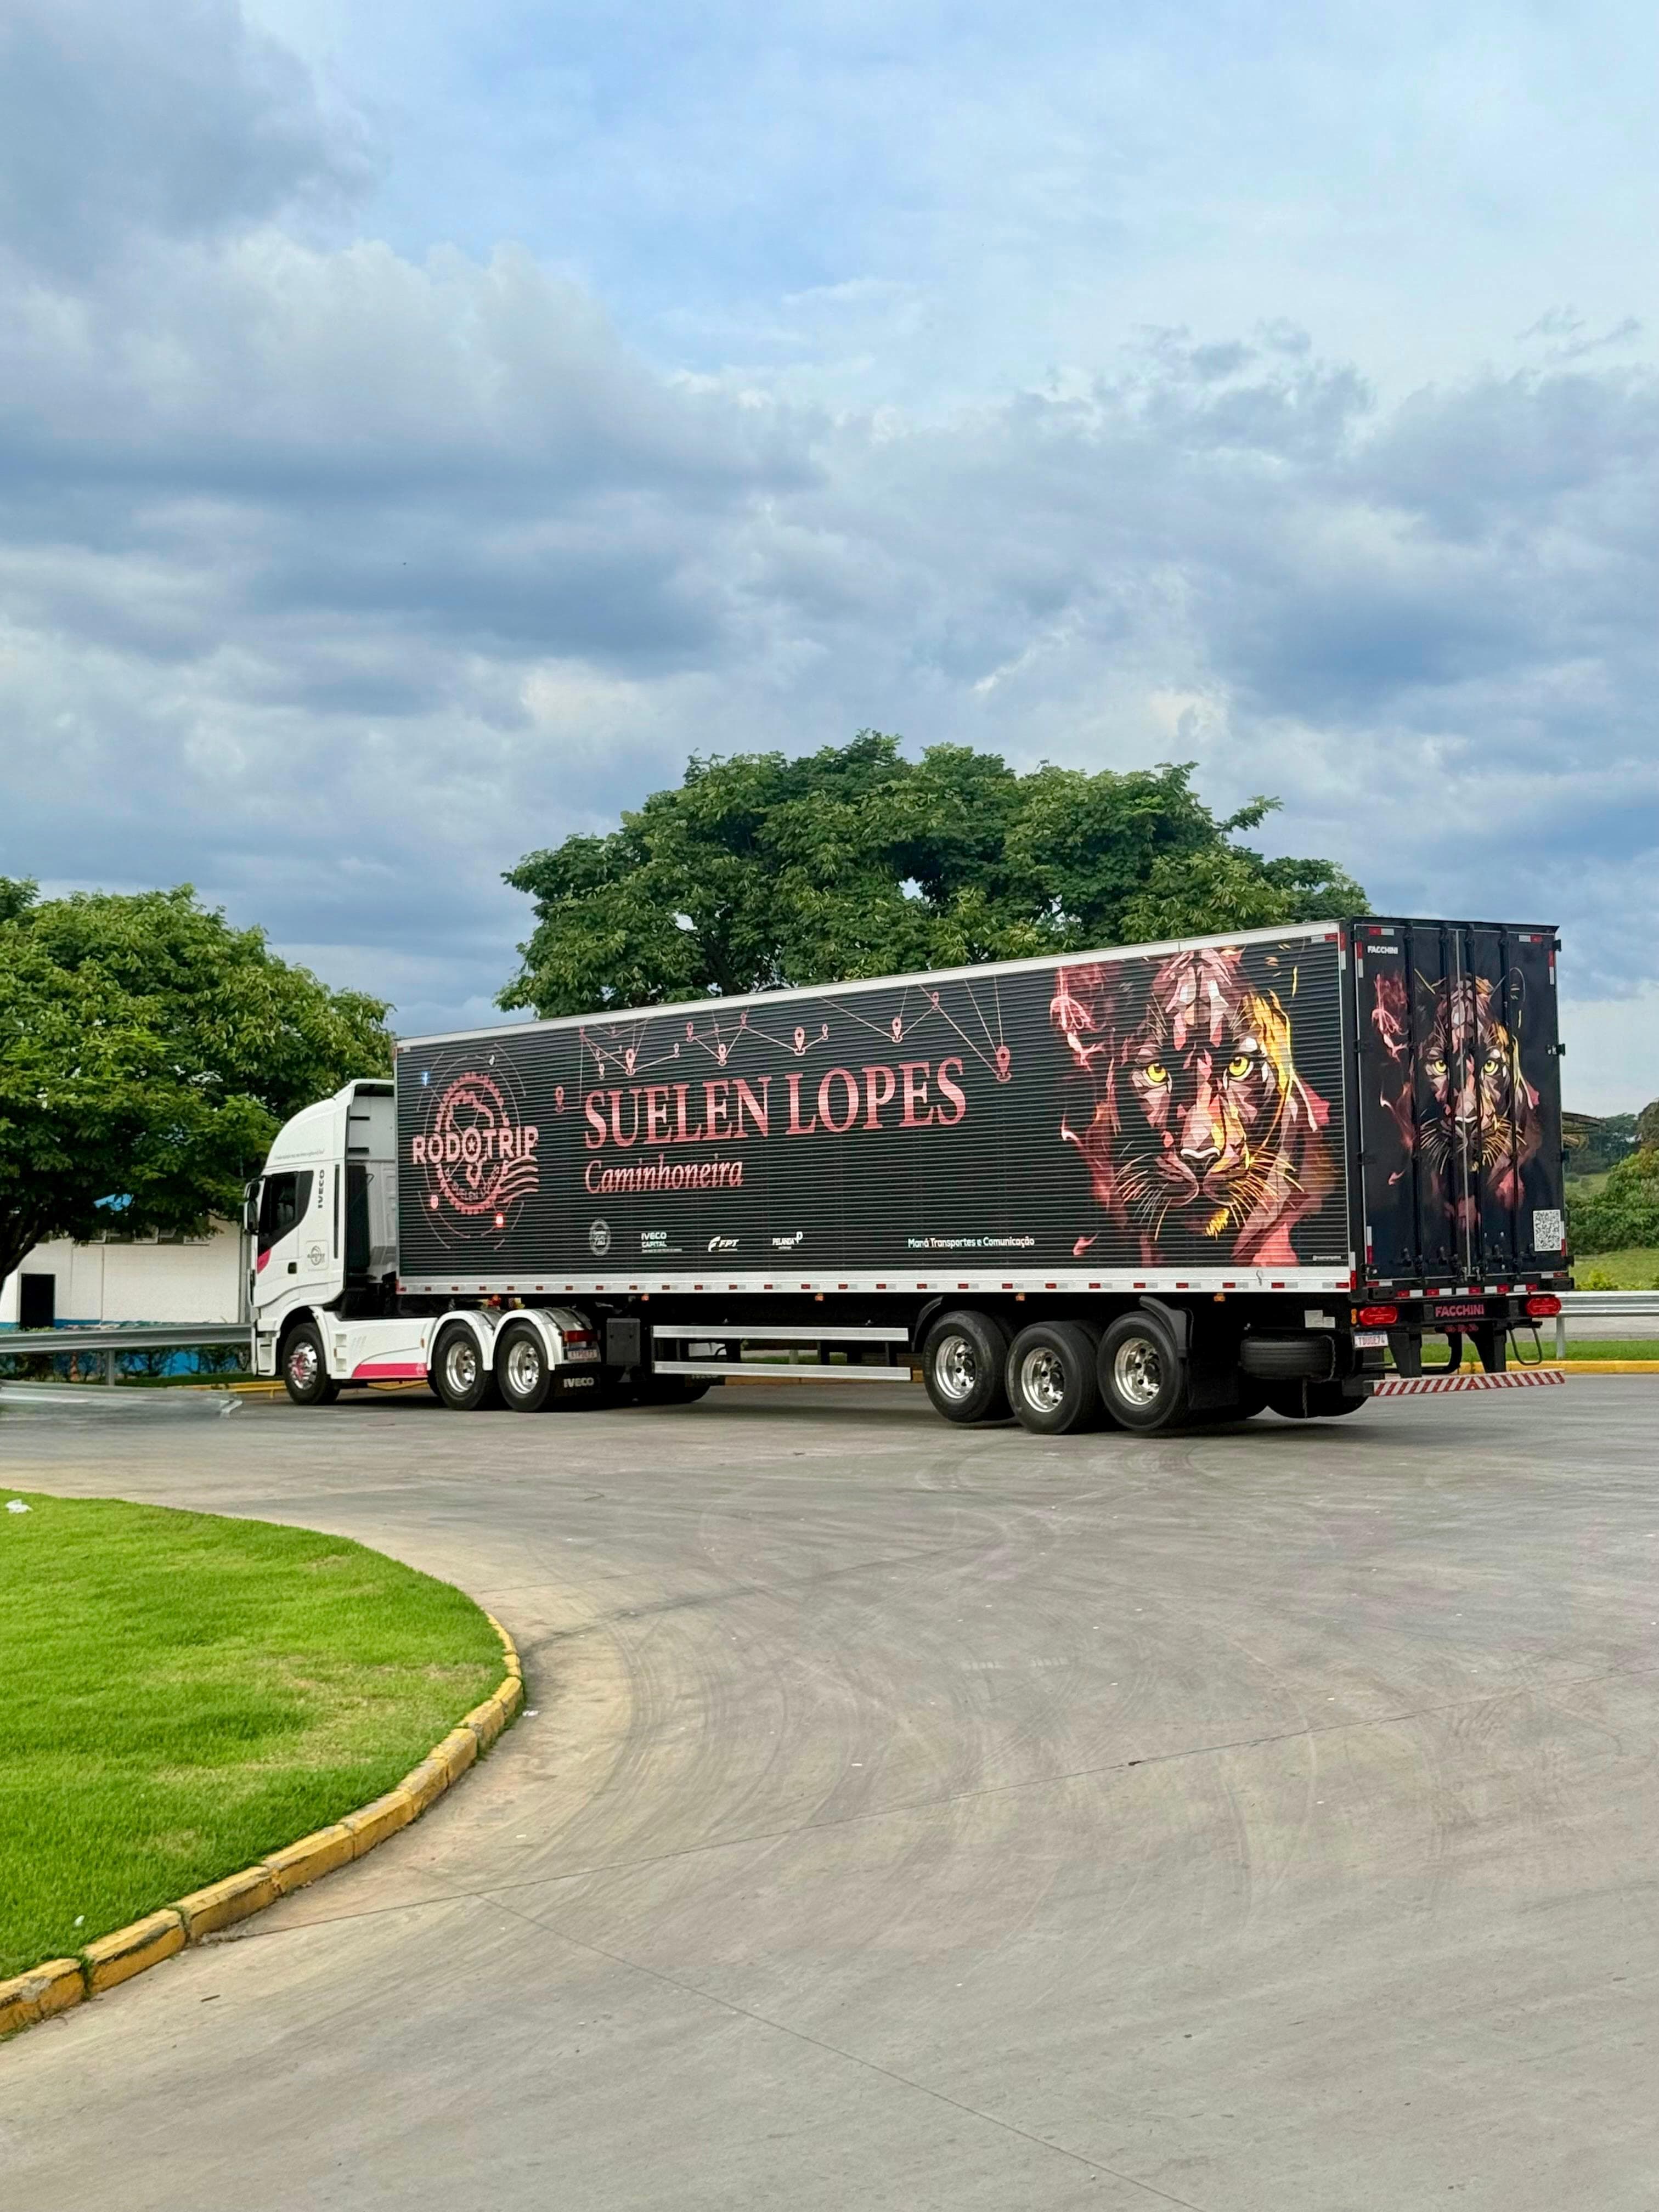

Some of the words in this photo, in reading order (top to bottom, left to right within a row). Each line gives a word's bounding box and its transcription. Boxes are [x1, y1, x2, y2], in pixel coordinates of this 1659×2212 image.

[1367, 946, 1398, 955] FACCHINI
[585, 1075, 772, 1149] SUELEN
[785, 1057, 966, 1135] LOPES
[413, 1126, 539, 1165] RODOTRIP
[585, 1152, 744, 1194] Caminhoneira
[641, 1232, 667, 1240] IVECO
[907, 1238, 928, 1248] Maná
[929, 1237, 975, 1249] Transportes
[977, 1239, 982, 1247] e
[983, 1236, 1035, 1248] Comunicação
[718, 1239, 740, 1248] FPT
[1435, 1304, 1485, 1317] FACCHINI
[563, 1377, 595, 1388] IVECO
